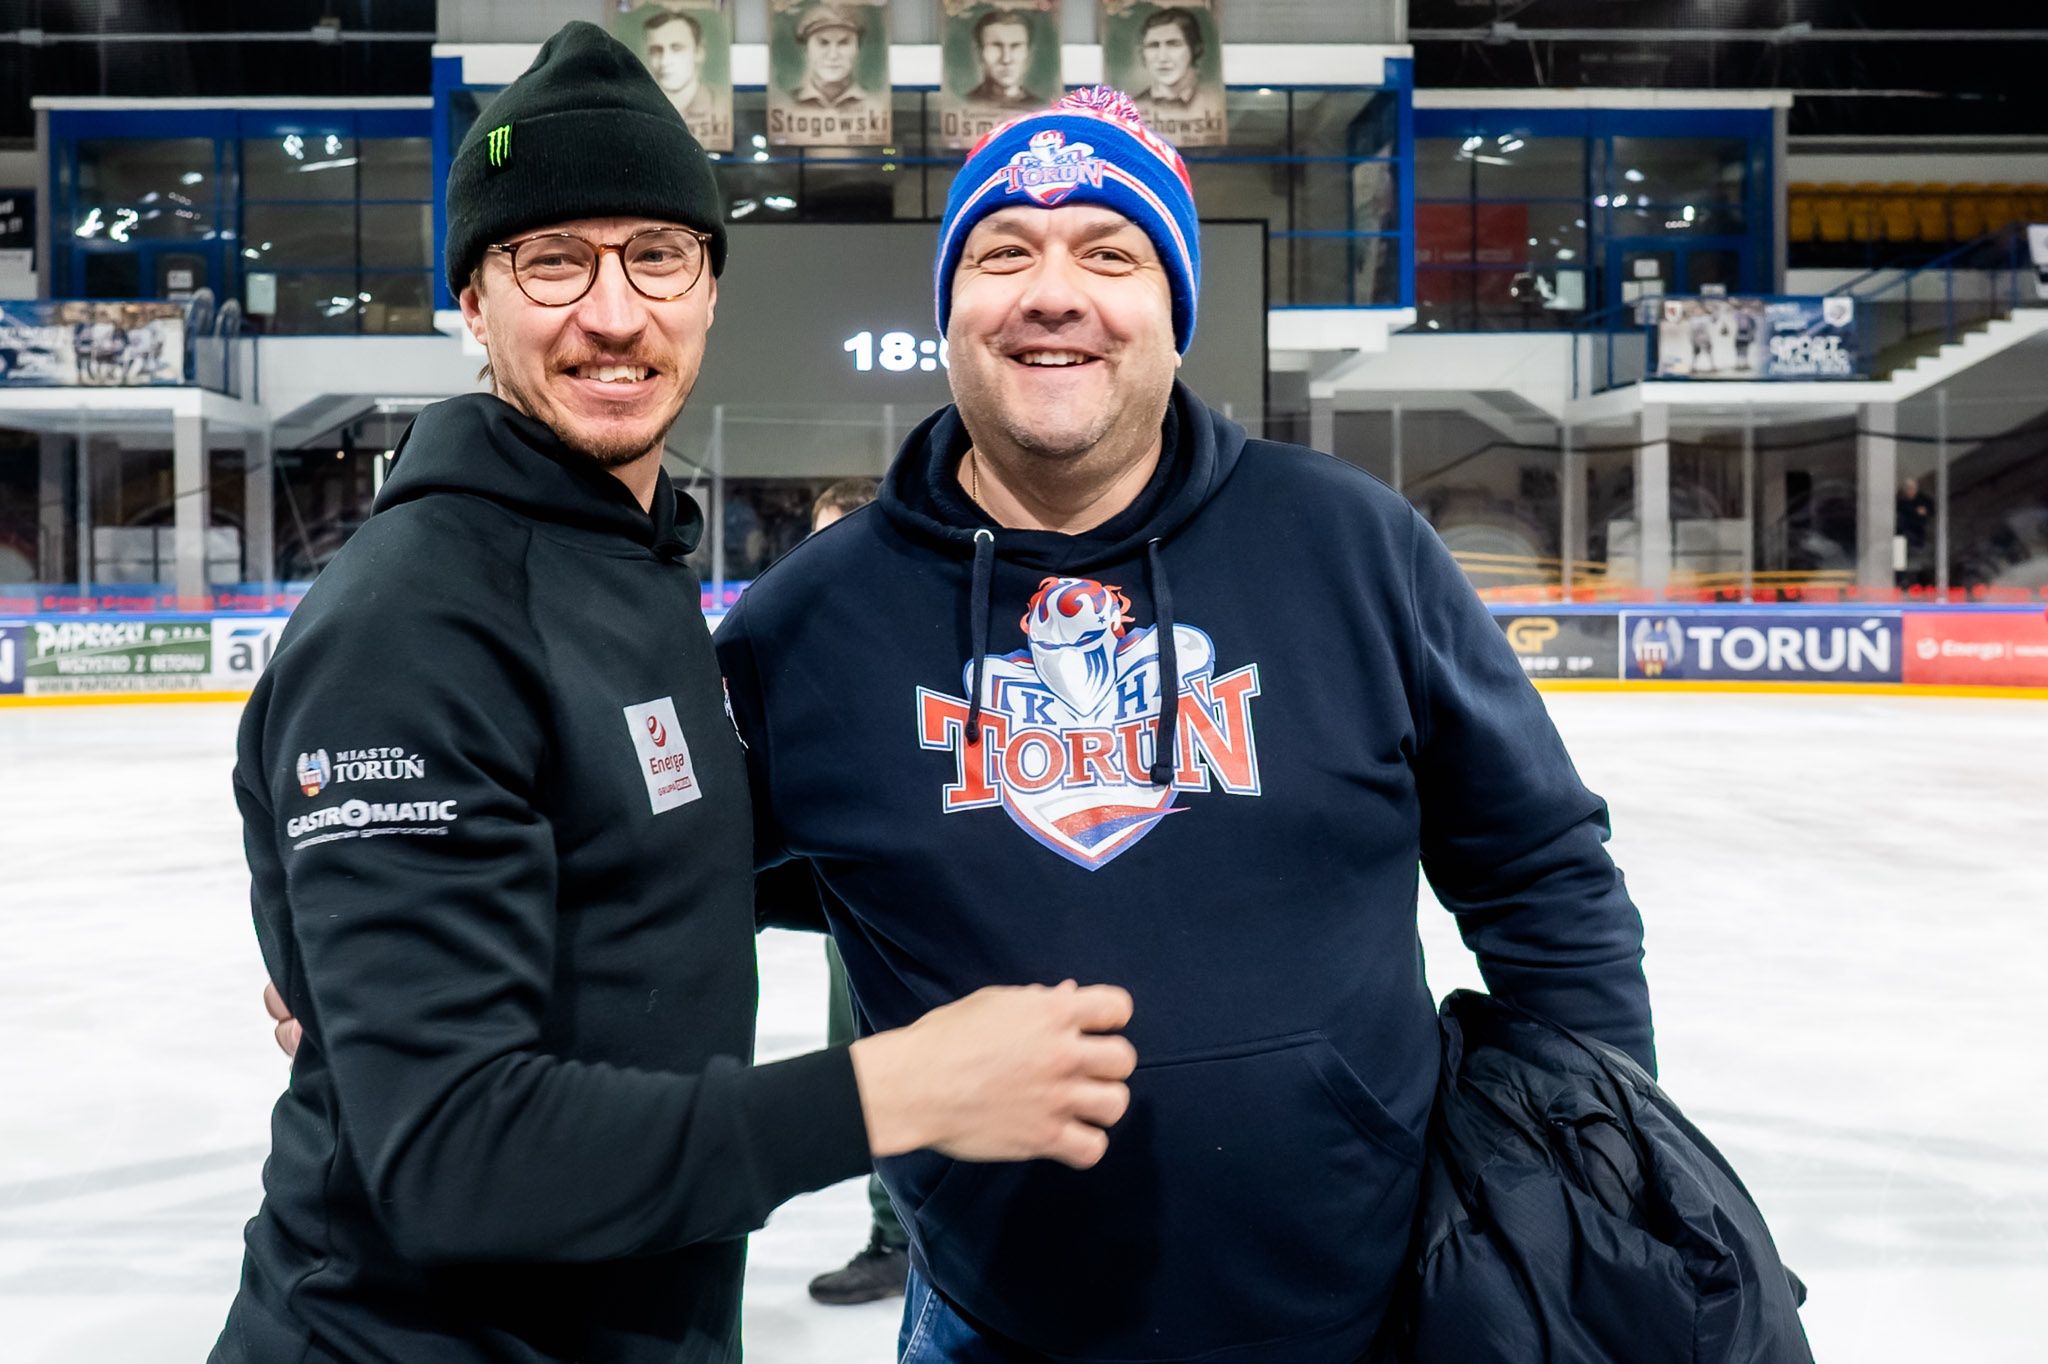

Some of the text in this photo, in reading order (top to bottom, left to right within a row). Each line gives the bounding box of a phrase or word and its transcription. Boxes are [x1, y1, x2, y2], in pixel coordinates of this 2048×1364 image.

[771, 108, 888, 137] Stogowski
[944, 112, 1003, 136] Osm
[844, 331, 950, 372] 18:
[1686, 618, 1891, 673] TORUŃ
[333, 754, 425, 783] TORUŃ
[336, 747, 404, 762] MIASTO
[649, 753, 685, 775] Energa
[287, 799, 458, 838] GASTROMATIC
